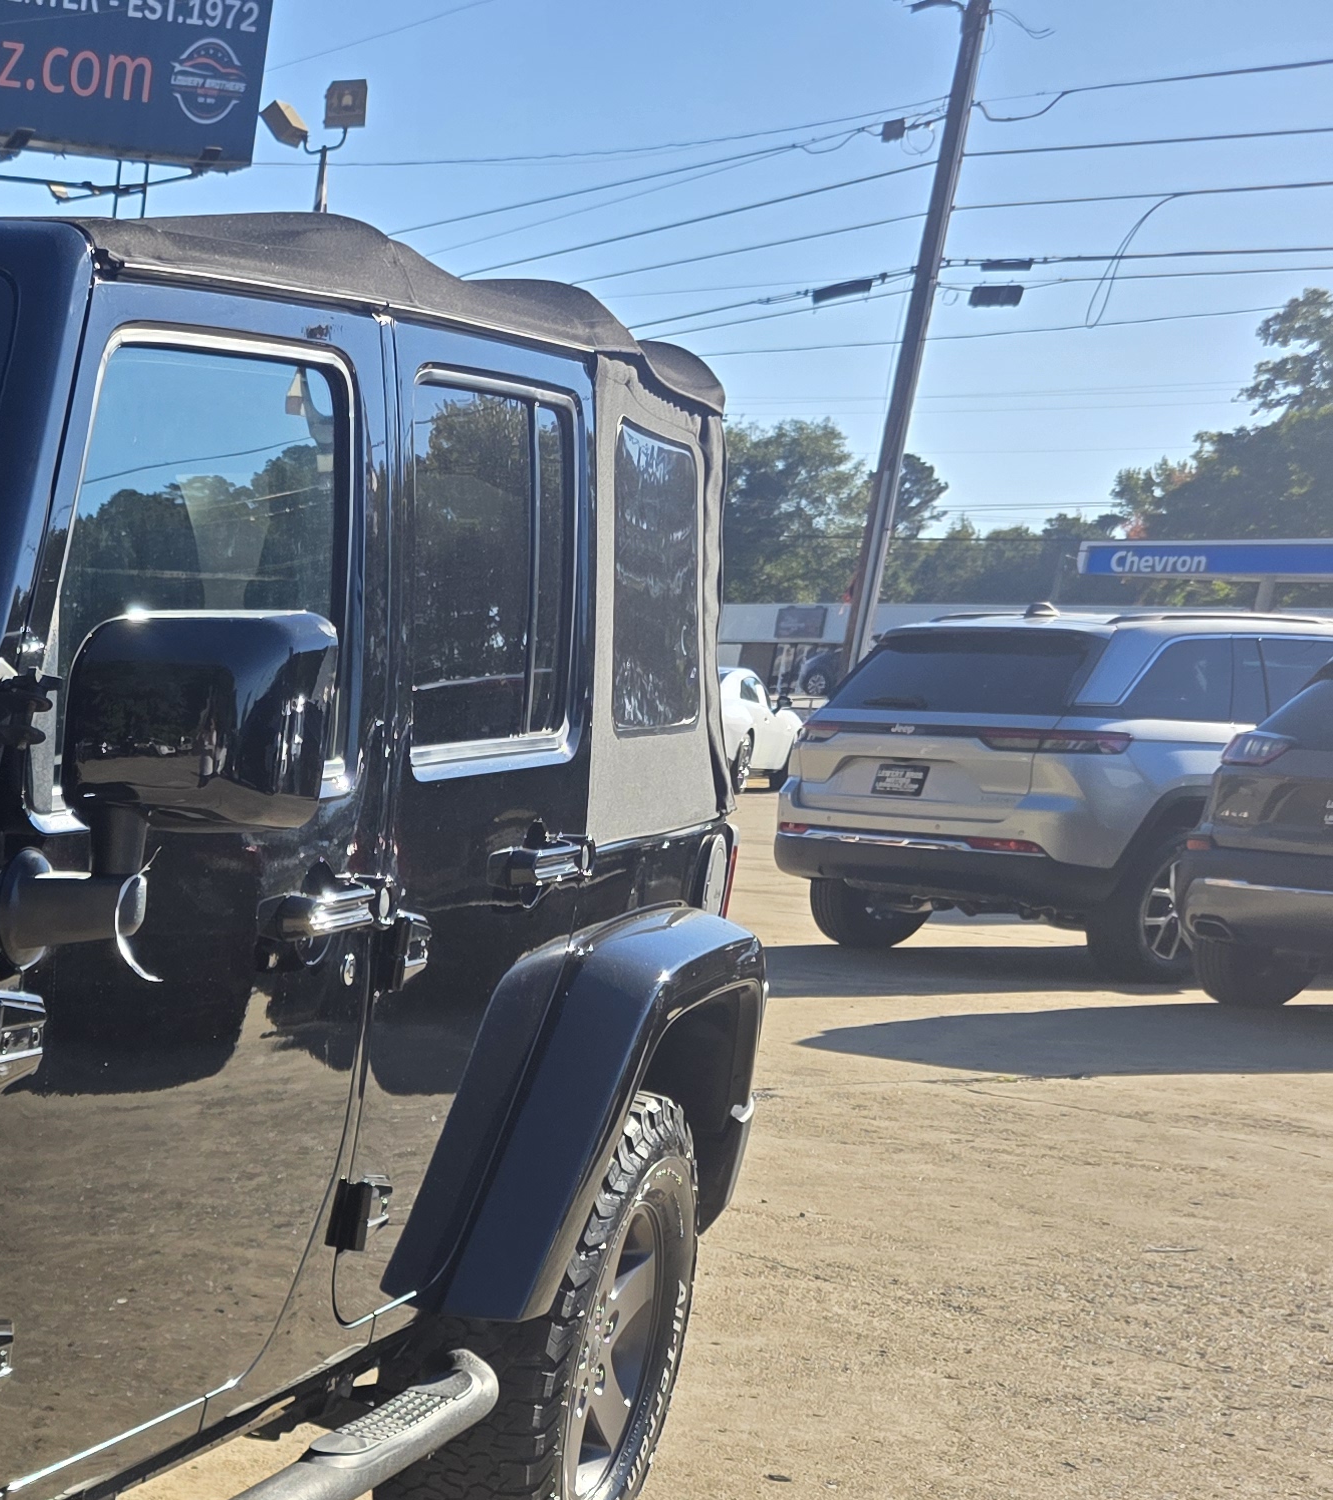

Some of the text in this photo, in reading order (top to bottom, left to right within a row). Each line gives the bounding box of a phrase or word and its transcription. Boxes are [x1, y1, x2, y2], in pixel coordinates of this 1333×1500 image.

[127, 0, 260, 33] EST.1972
[1110, 551, 1207, 573] Chevron
[890, 722, 916, 735] Jeep
